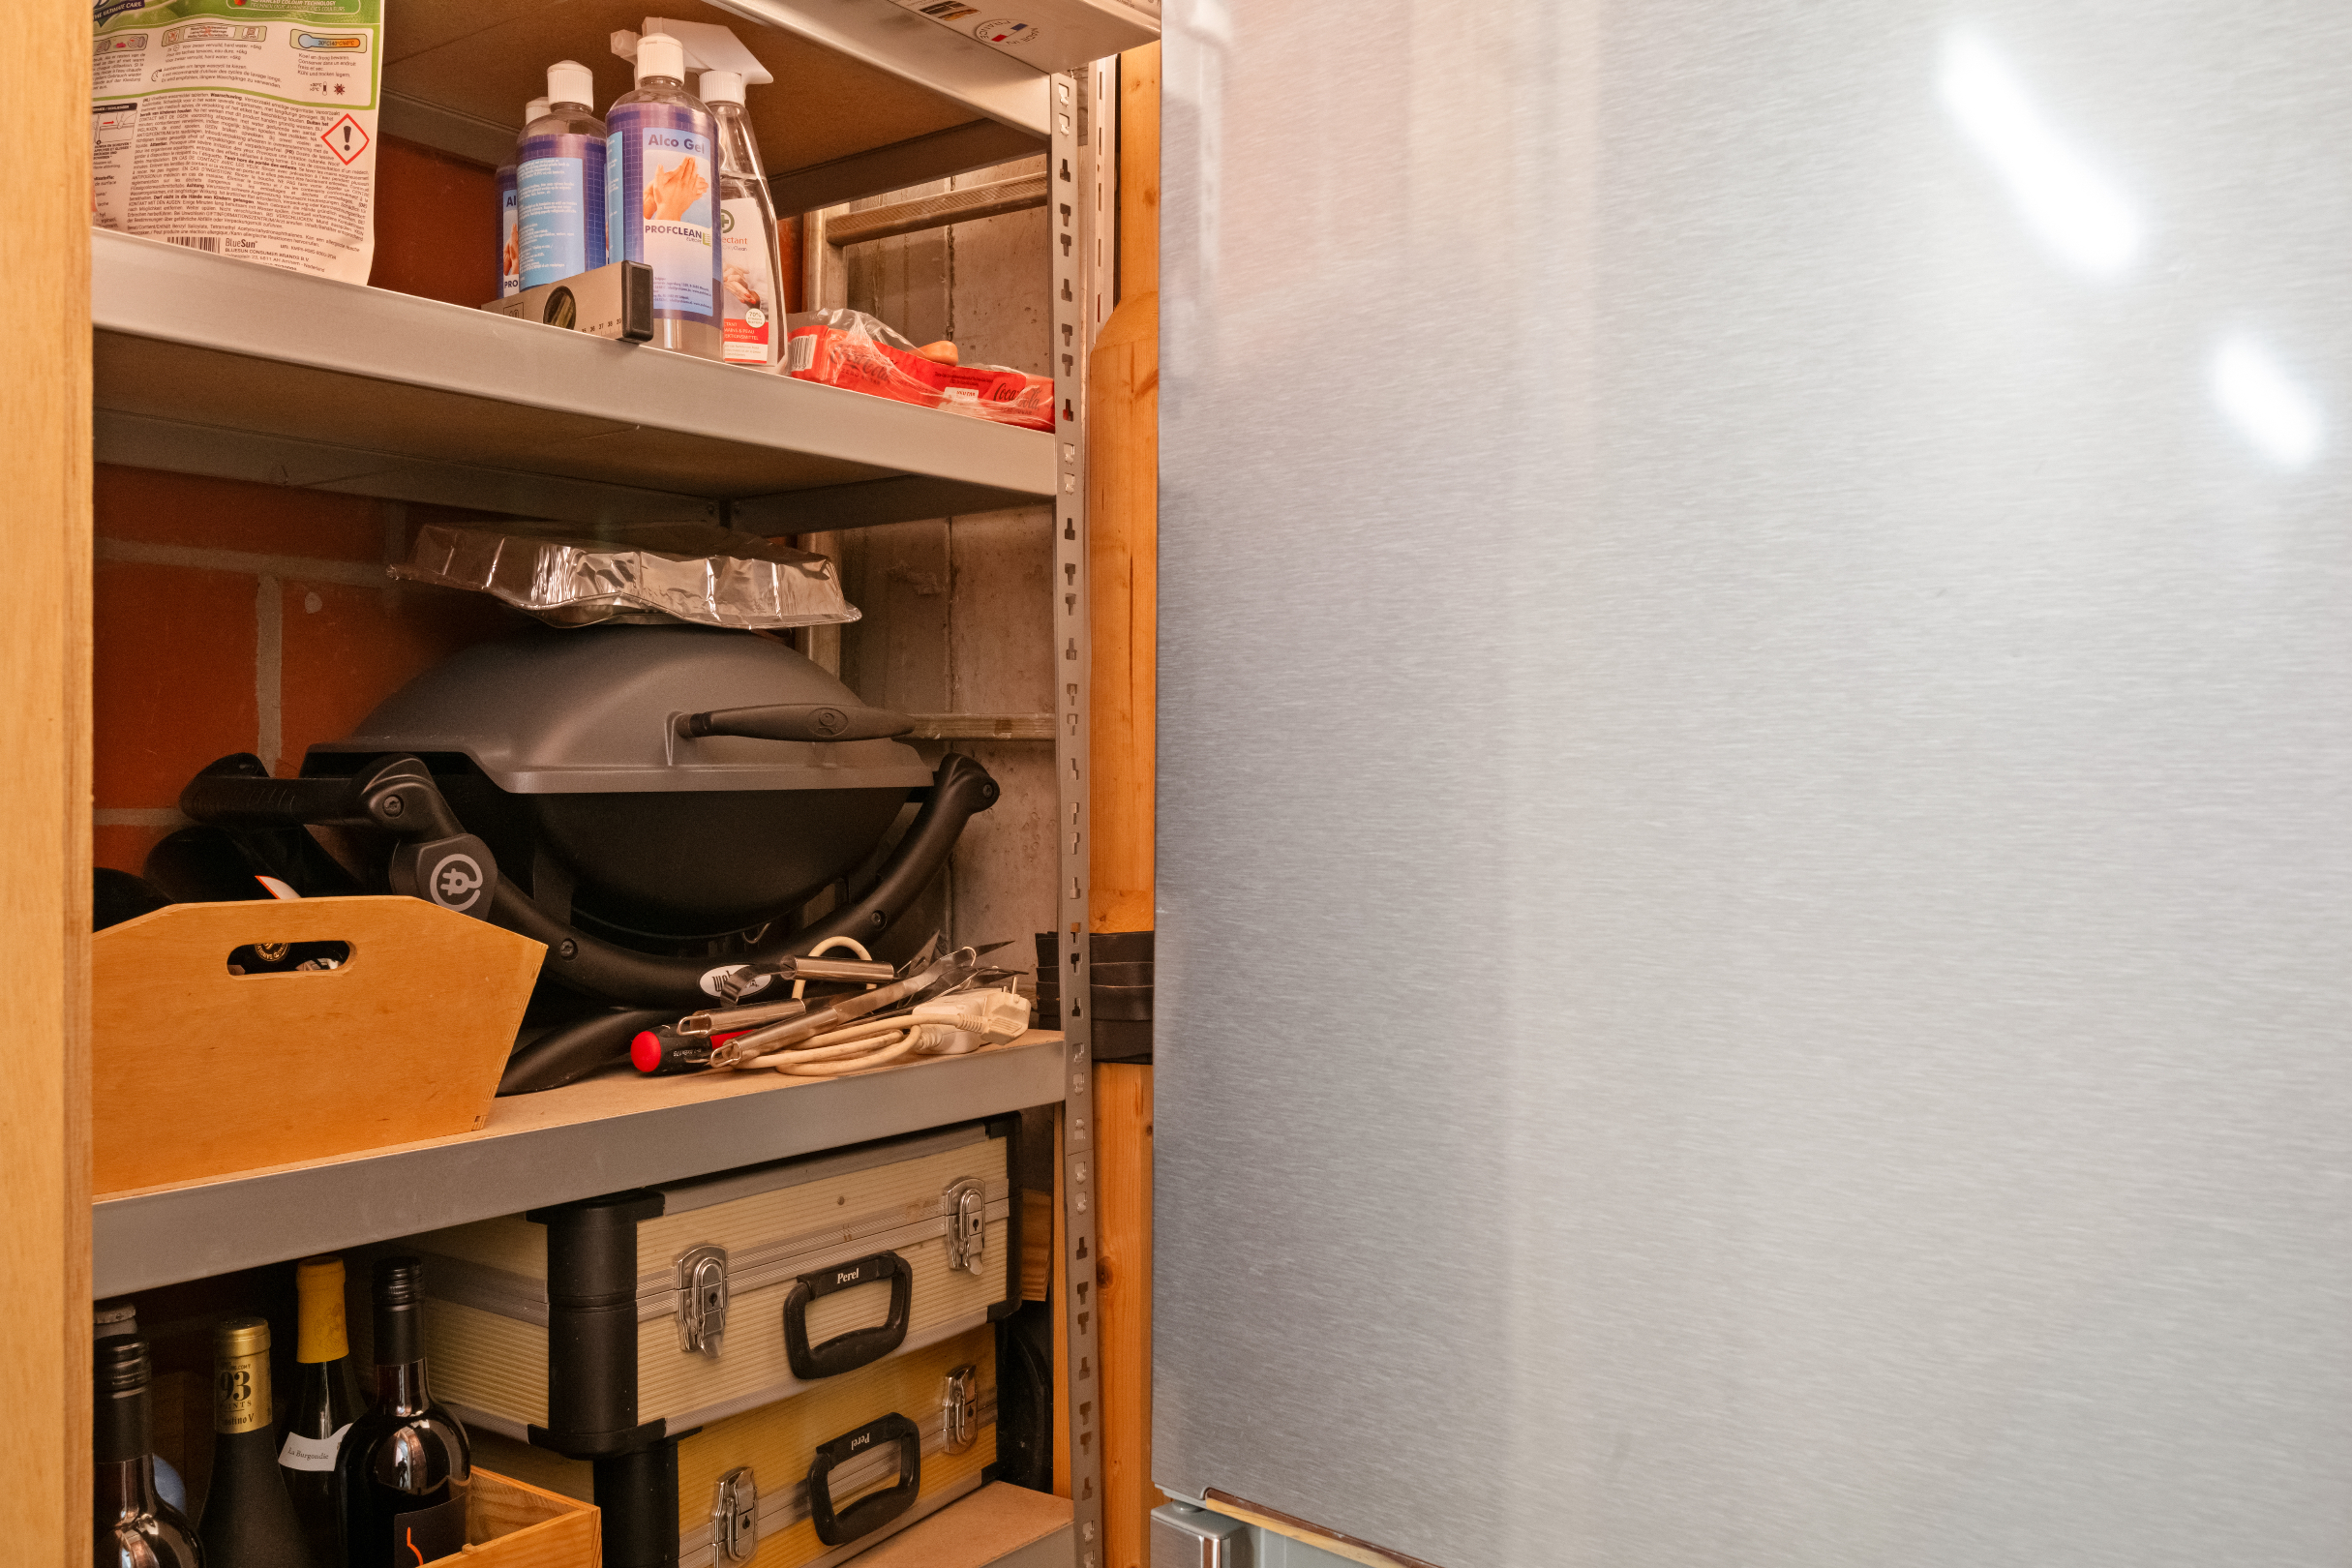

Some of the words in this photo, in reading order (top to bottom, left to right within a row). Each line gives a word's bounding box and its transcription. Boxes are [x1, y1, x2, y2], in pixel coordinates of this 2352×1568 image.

[104, 4, 125, 16] ULTIMATE
[648, 134, 679, 148] Alco
[683, 138, 705, 154] Gel
[645, 225, 702, 240] PROFCLEAN
[249, 249, 278, 257] CONSUMER
[837, 1267, 859, 1284] Perel
[220, 1371, 251, 1402] 93
[248, 1413, 254, 1422] V
[851, 1432, 870, 1450] Perel
[288, 1447, 295, 1455] La
[296, 1449, 329, 1461] Burgondie
